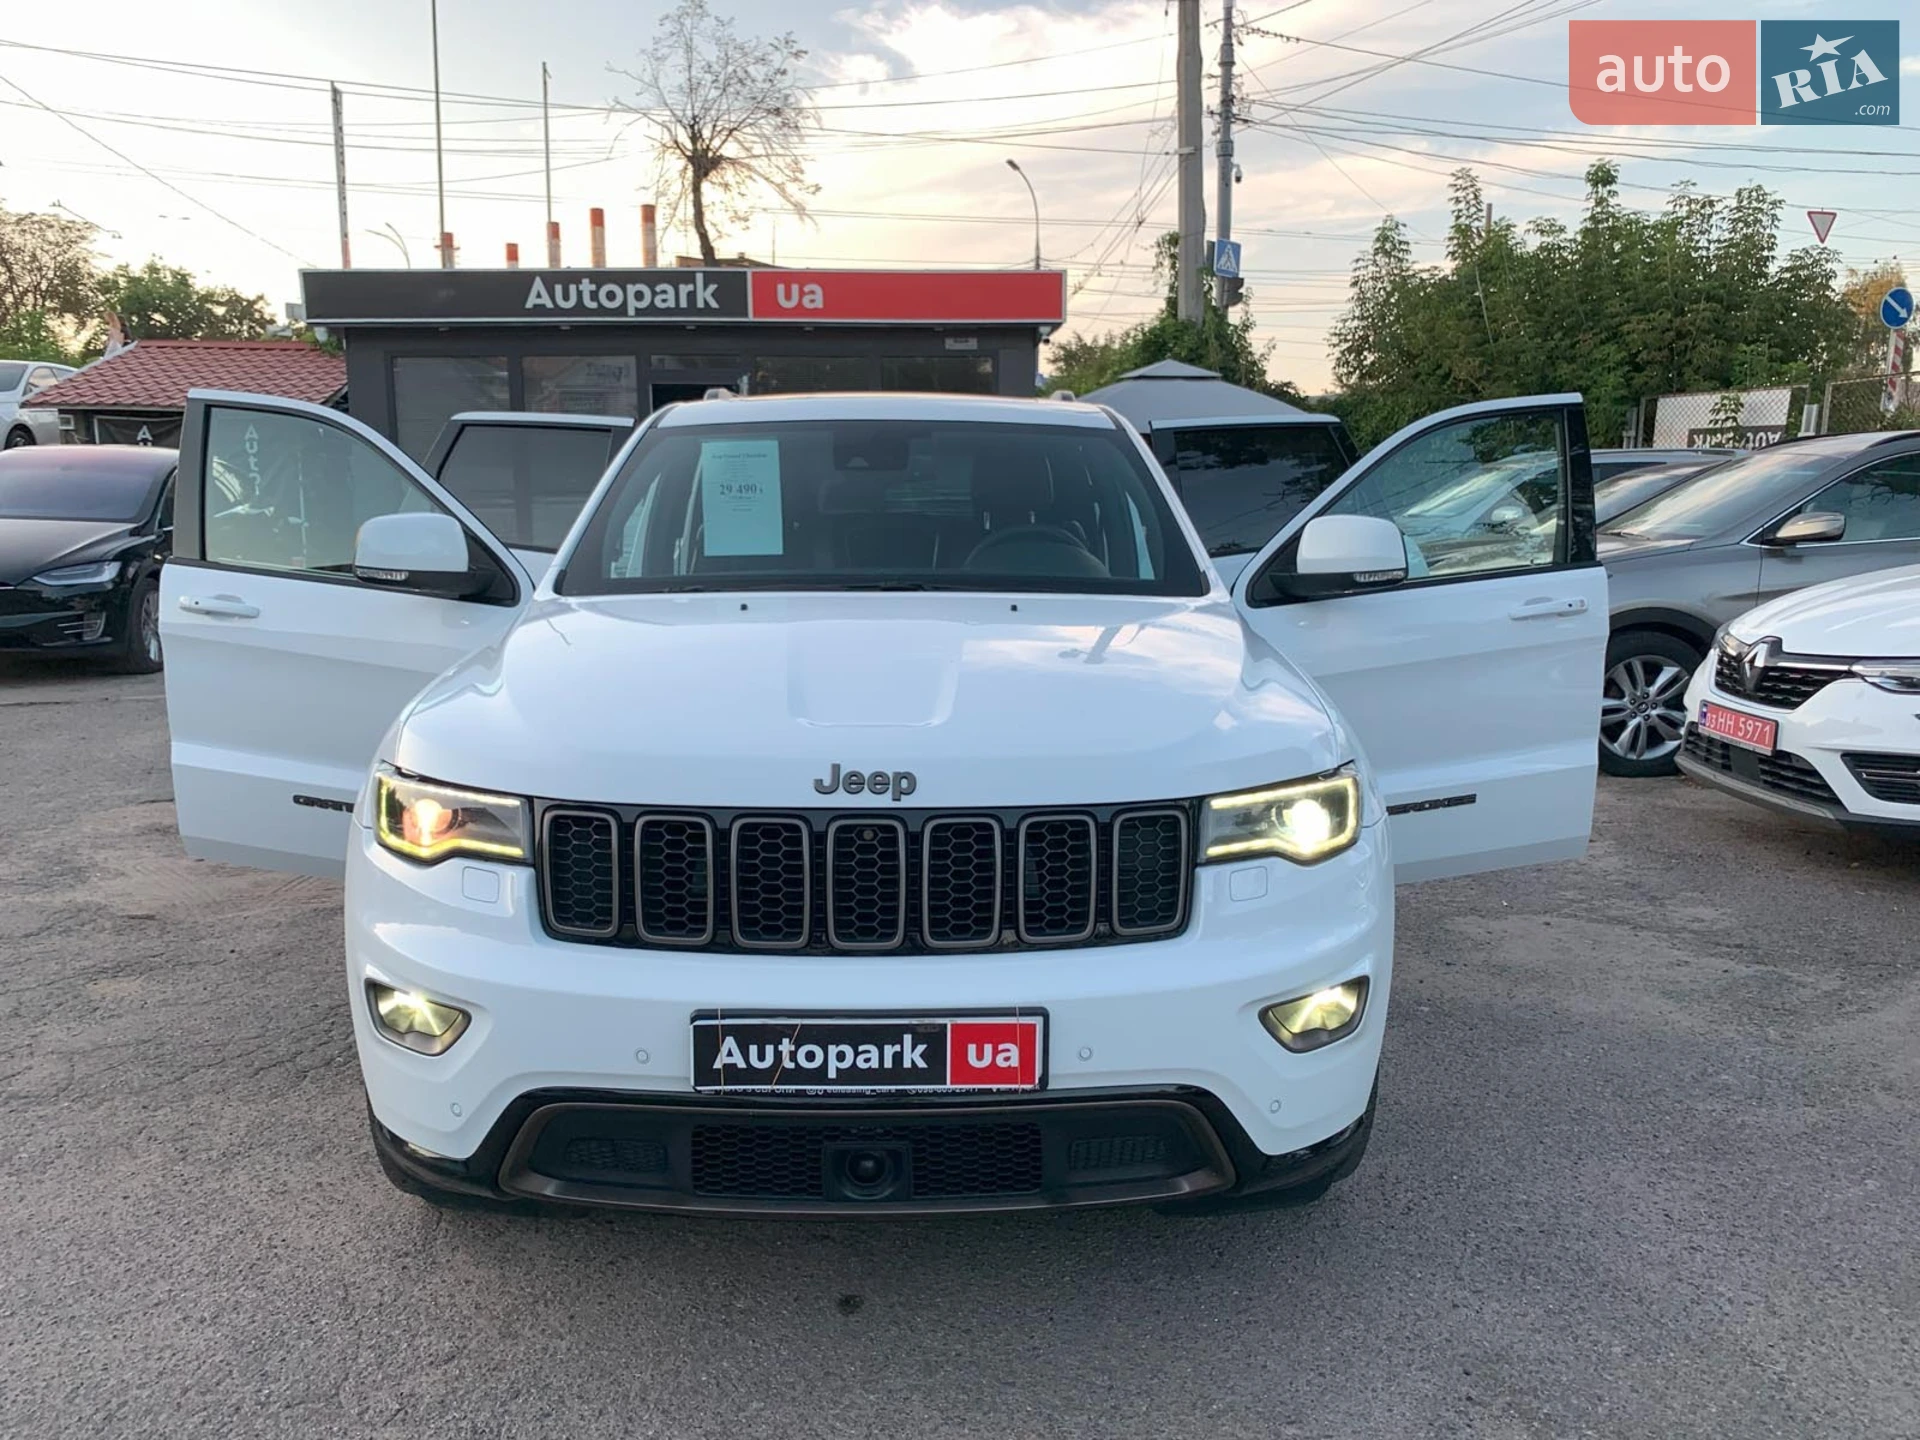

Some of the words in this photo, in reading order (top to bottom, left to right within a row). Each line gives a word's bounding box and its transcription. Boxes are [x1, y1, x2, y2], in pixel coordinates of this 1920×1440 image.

[524, 272, 720, 317] Autopark
[776, 283, 824, 309] ua
[719, 484, 733, 495] 29
[736, 483, 757, 494] 490
[1737, 717, 1772, 745] 5971
[813, 763, 917, 802] Jeep
[712, 1033, 929, 1079] Autopark
[967, 1042, 1020, 1069] ua
